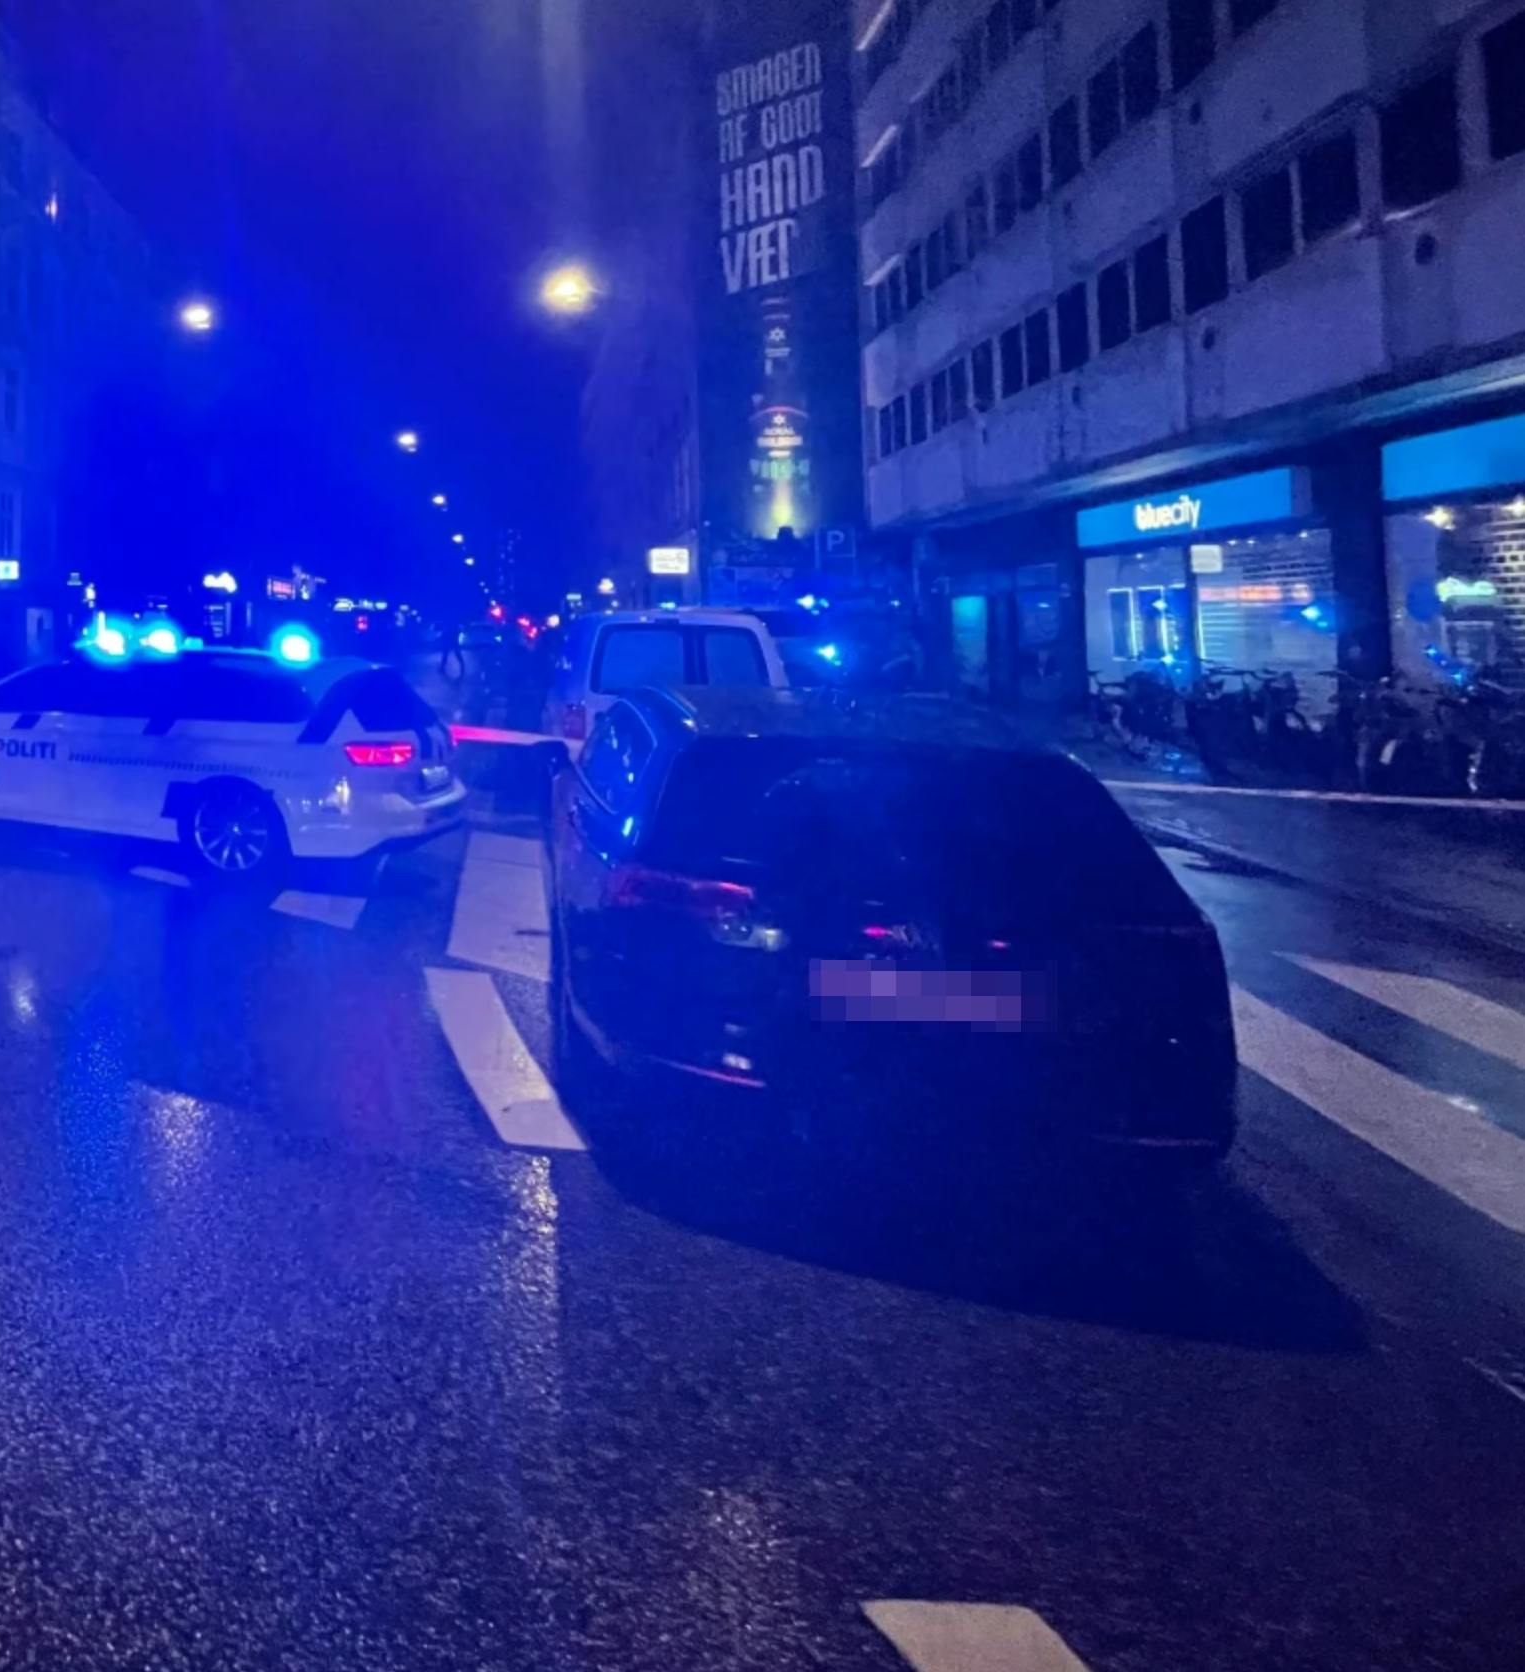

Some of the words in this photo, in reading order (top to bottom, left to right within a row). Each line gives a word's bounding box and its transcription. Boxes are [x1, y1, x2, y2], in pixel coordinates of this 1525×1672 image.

[716, 41, 824, 116] SMAGEN
[719, 112, 748, 164] AF
[720, 144, 825, 232] HAND
[1135, 494, 1201, 531] bluecity
[826, 530, 845, 552] P
